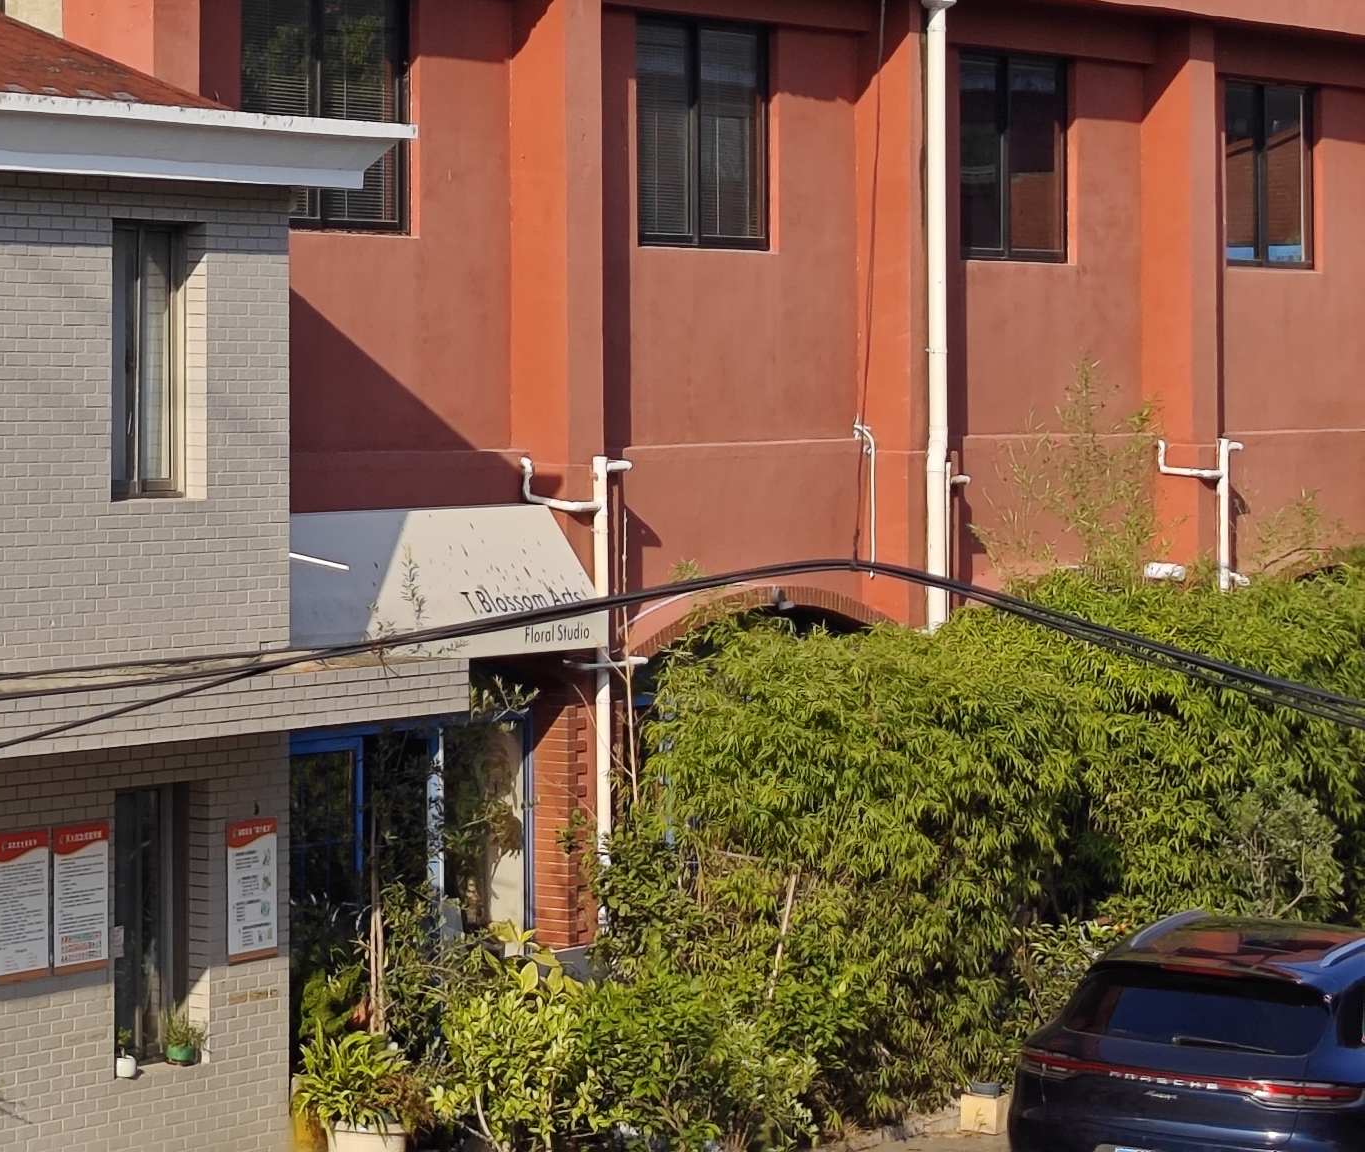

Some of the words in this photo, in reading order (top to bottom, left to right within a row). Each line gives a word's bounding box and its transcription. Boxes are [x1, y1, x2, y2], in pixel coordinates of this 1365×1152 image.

[549, 587, 582, 607] Arts
[525, 625, 555, 644] Floral
[558, 622, 590, 642] Studio
